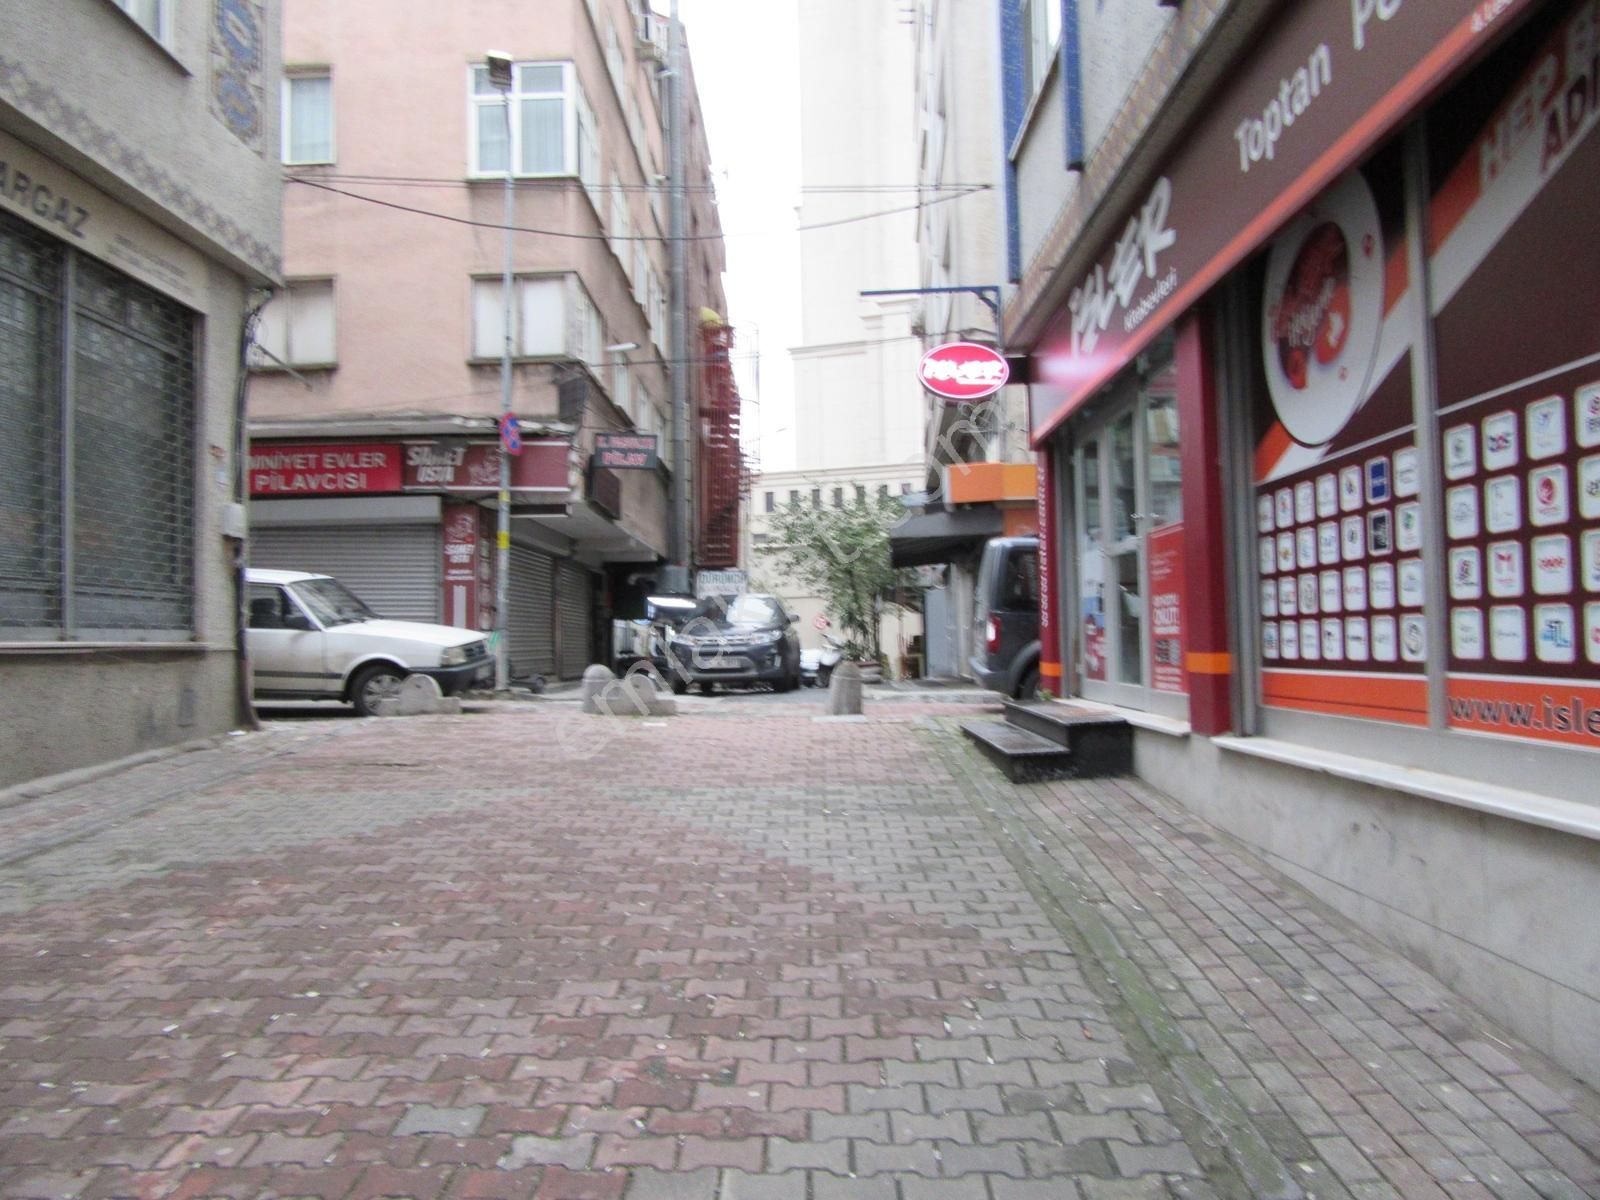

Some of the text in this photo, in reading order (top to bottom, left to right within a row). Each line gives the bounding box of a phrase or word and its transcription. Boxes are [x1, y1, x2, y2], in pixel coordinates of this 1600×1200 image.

[1233, 42, 1332, 173] Toptan
[322, 452, 387, 470] EVLER
[254, 471, 367, 490] PİLAVCISI
